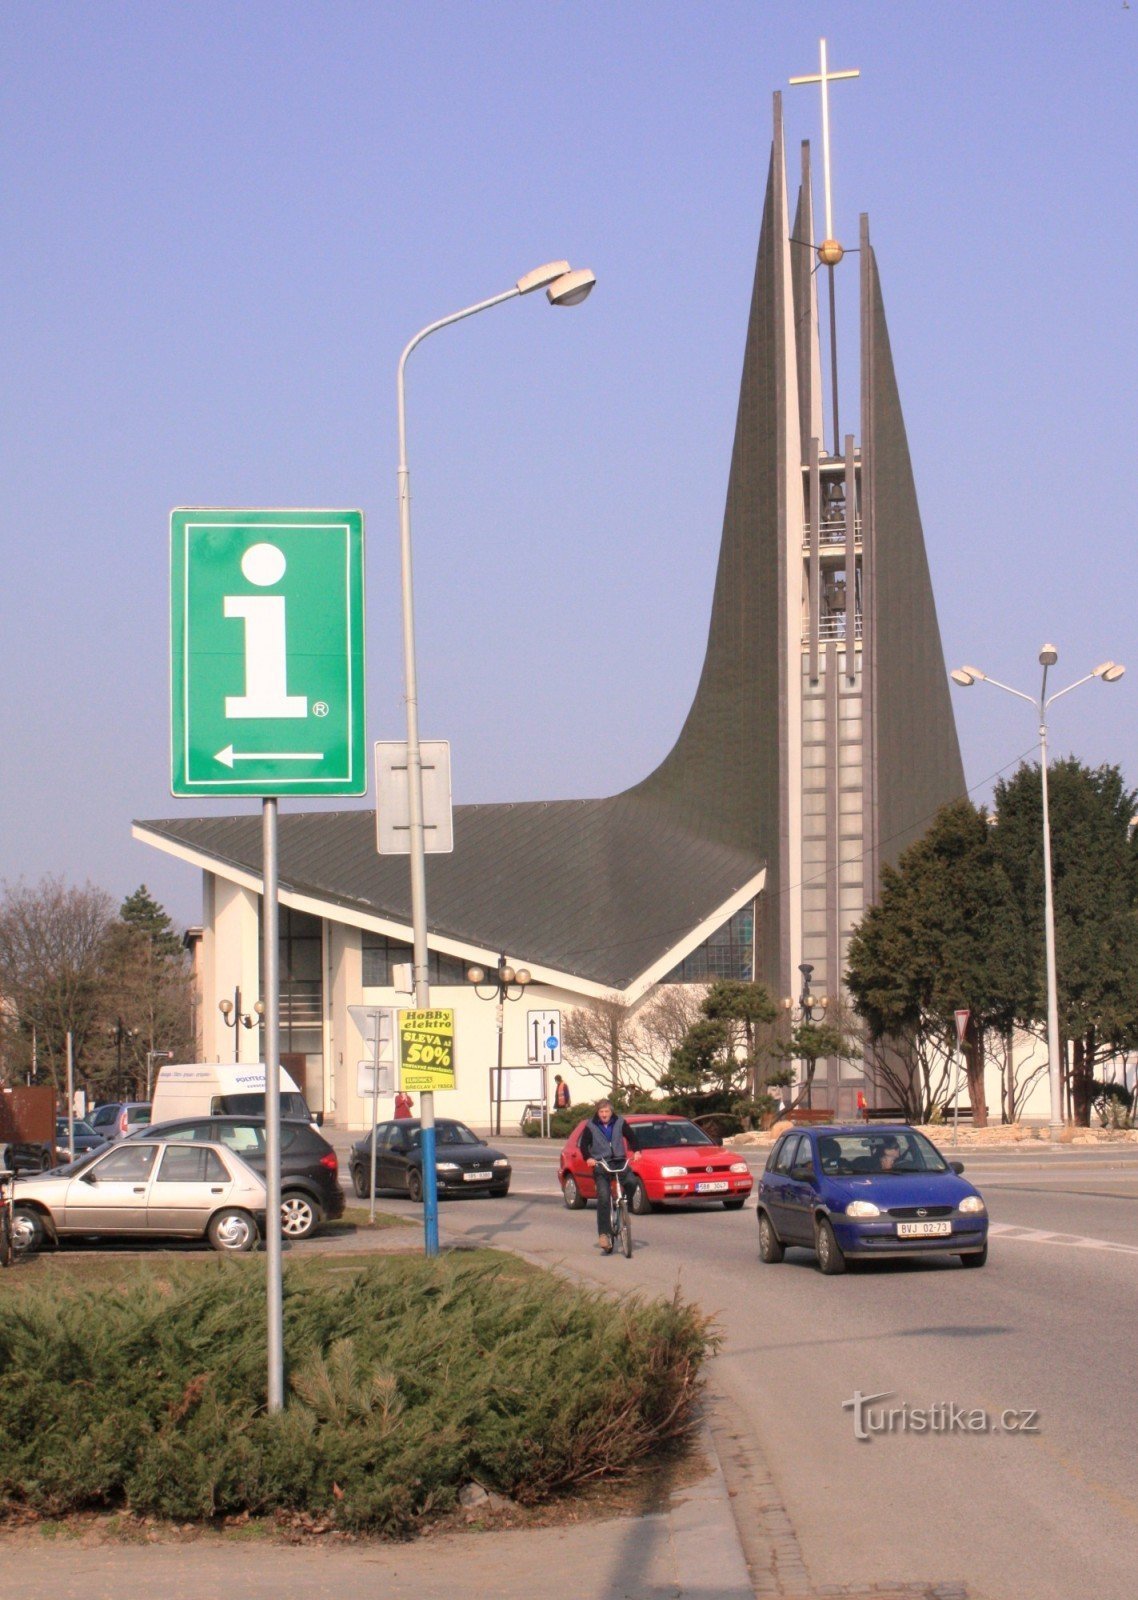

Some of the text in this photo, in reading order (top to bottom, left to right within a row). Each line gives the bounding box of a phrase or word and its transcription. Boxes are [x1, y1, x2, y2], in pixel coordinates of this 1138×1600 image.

[404, 1020, 451, 1029] elektro
[403, 1032, 441, 1045] SLEVA
[406, 1043, 450, 1066] 50%
[901, 1222, 947, 1234] BVJ 02-73
